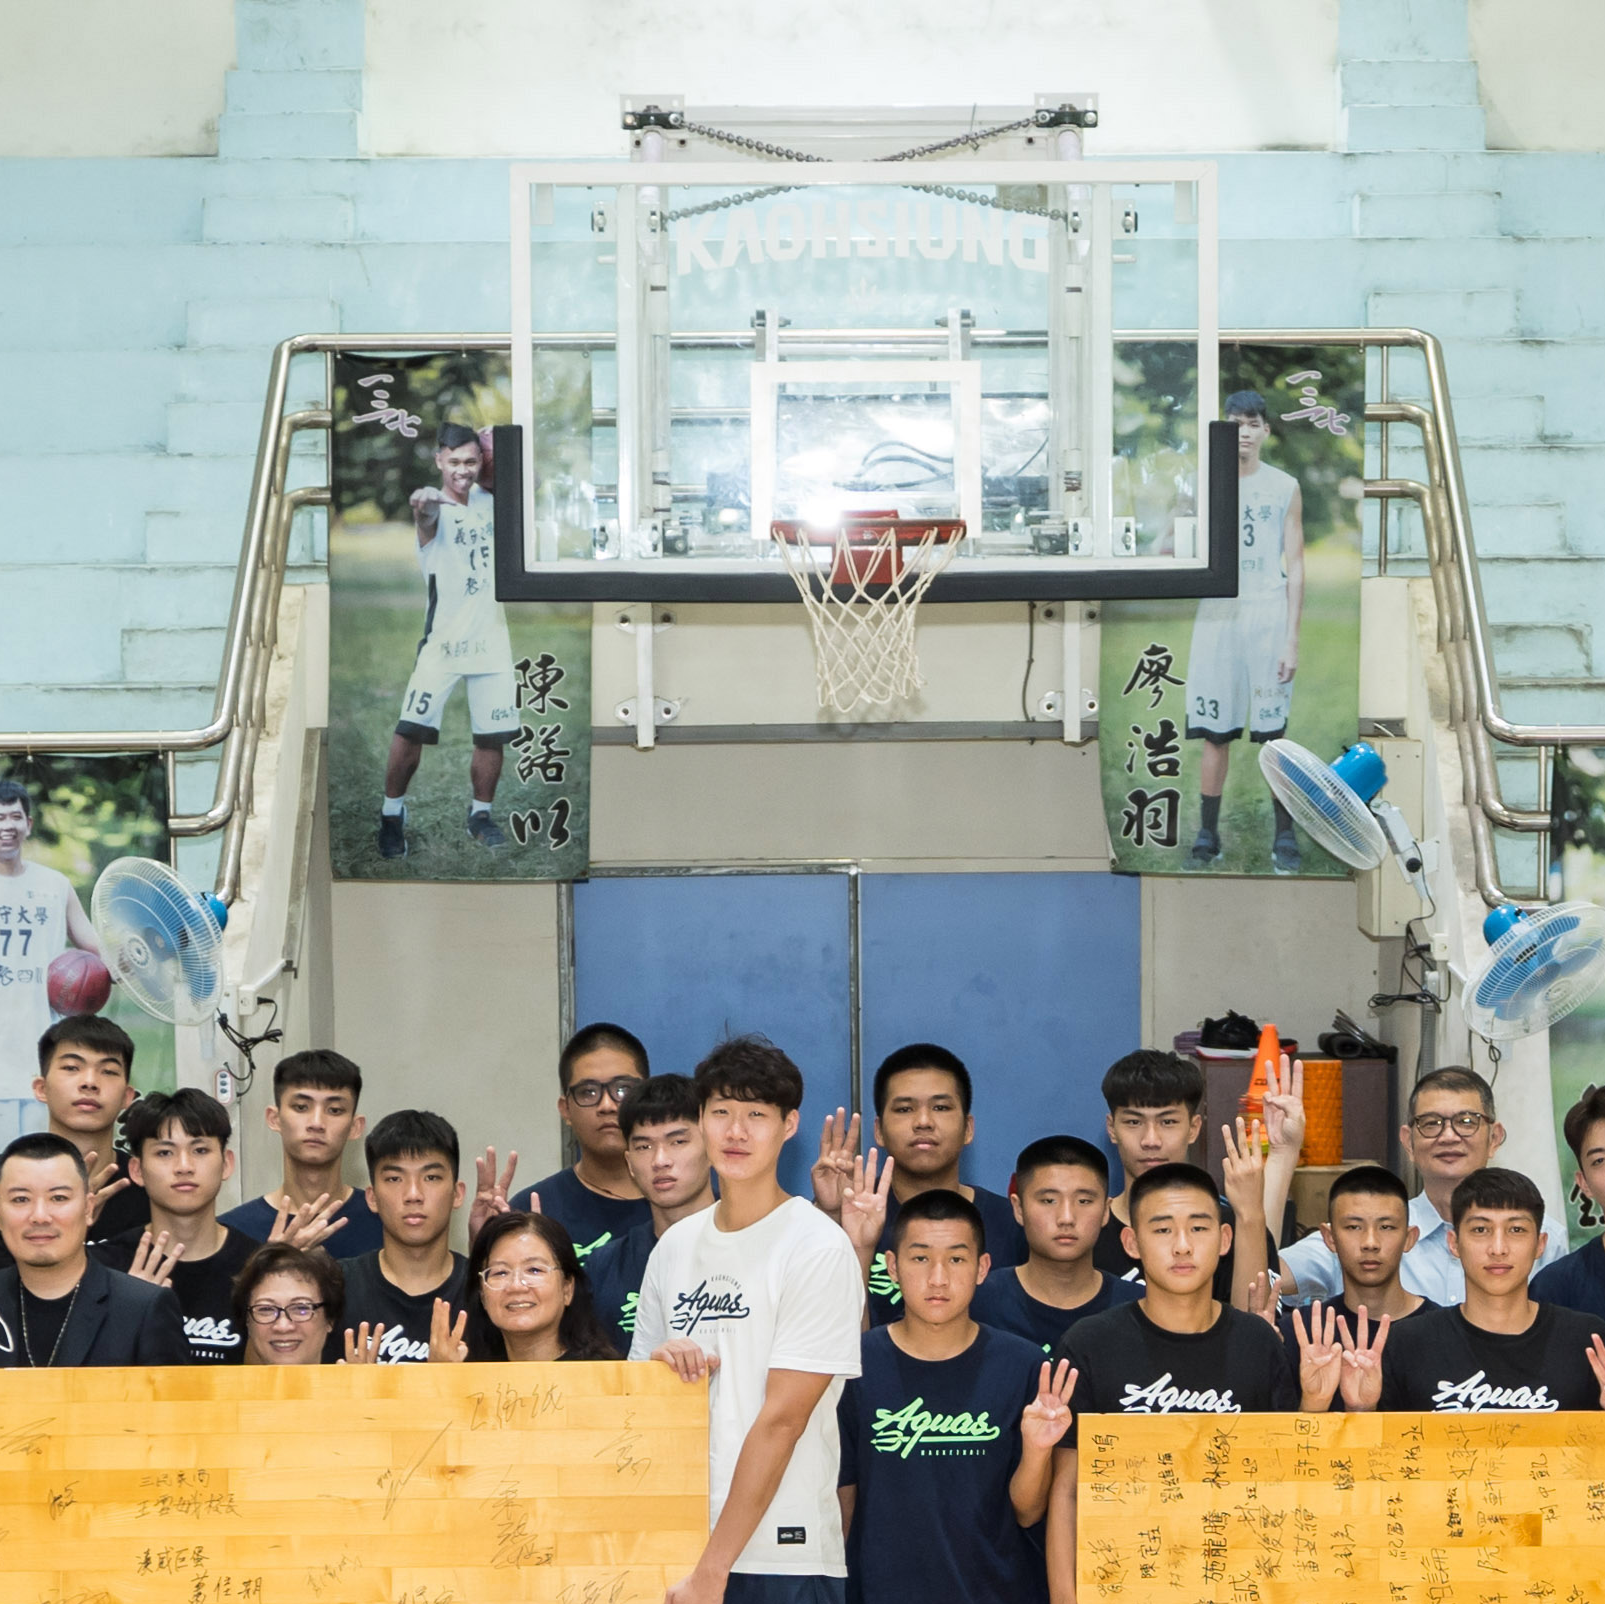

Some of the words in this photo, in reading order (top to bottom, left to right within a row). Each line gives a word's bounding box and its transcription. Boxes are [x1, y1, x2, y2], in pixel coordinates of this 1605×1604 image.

[676, 199, 1049, 276] KAOHSIUNG
[406, 689, 433, 716] 15
[1195, 696, 1220, 720] 33
[673, 1280, 750, 1336] Aquas
[1119, 1372, 1242, 1413] Aquas
[1432, 1370, 1560, 1413] Aquas
[871, 1397, 1001, 1459] Aquas
[1294, 1416, 1321, 1478] 許子恩
[1201, 1509, 1231, 1585] 施龍騰
